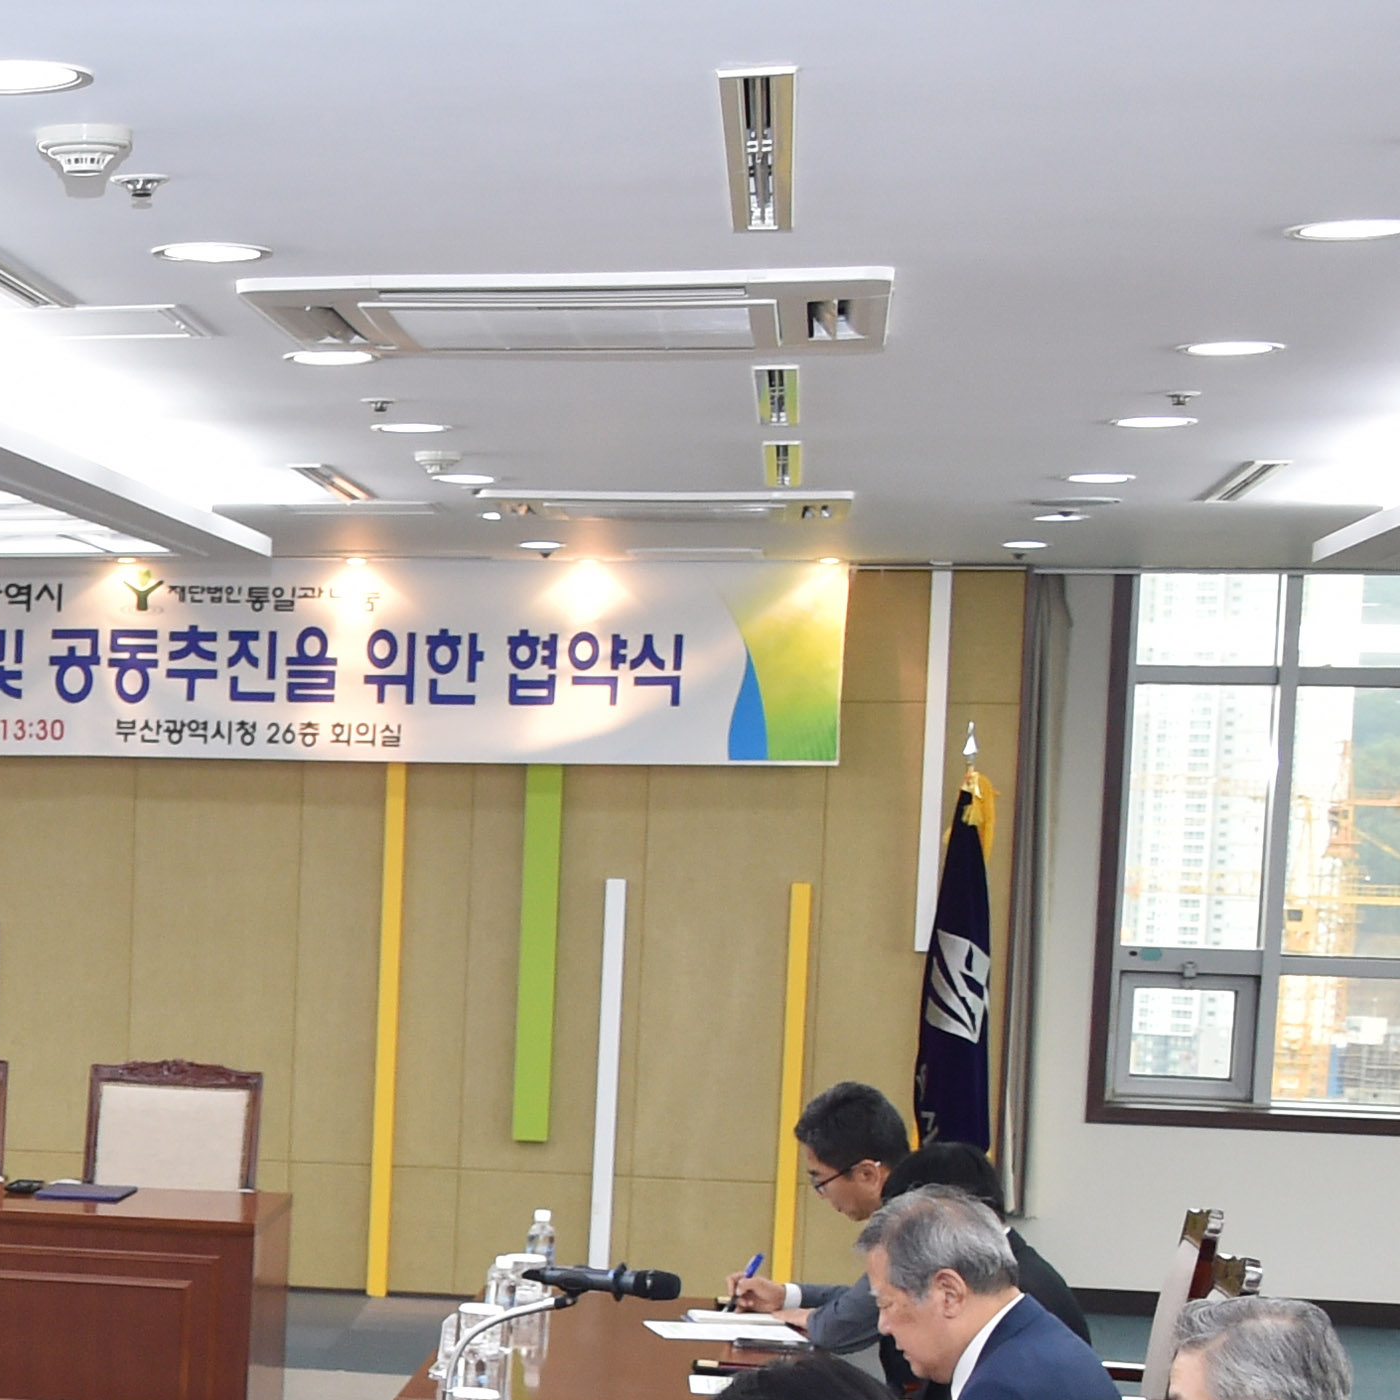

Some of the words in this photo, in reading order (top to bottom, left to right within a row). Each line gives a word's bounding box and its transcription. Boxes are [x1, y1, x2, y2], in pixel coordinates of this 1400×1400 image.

[168, 585, 242, 604] 재단법인
[48, 624, 338, 705] 공동추진을
[363, 627, 485, 706] 위한
[506, 628, 686, 707] 협약식
[0, 718, 65, 742] 13:30
[115, 718, 258, 748] 부산광역시청
[266, 720, 319, 748] 26층
[330, 721, 402, 748] 회의실
